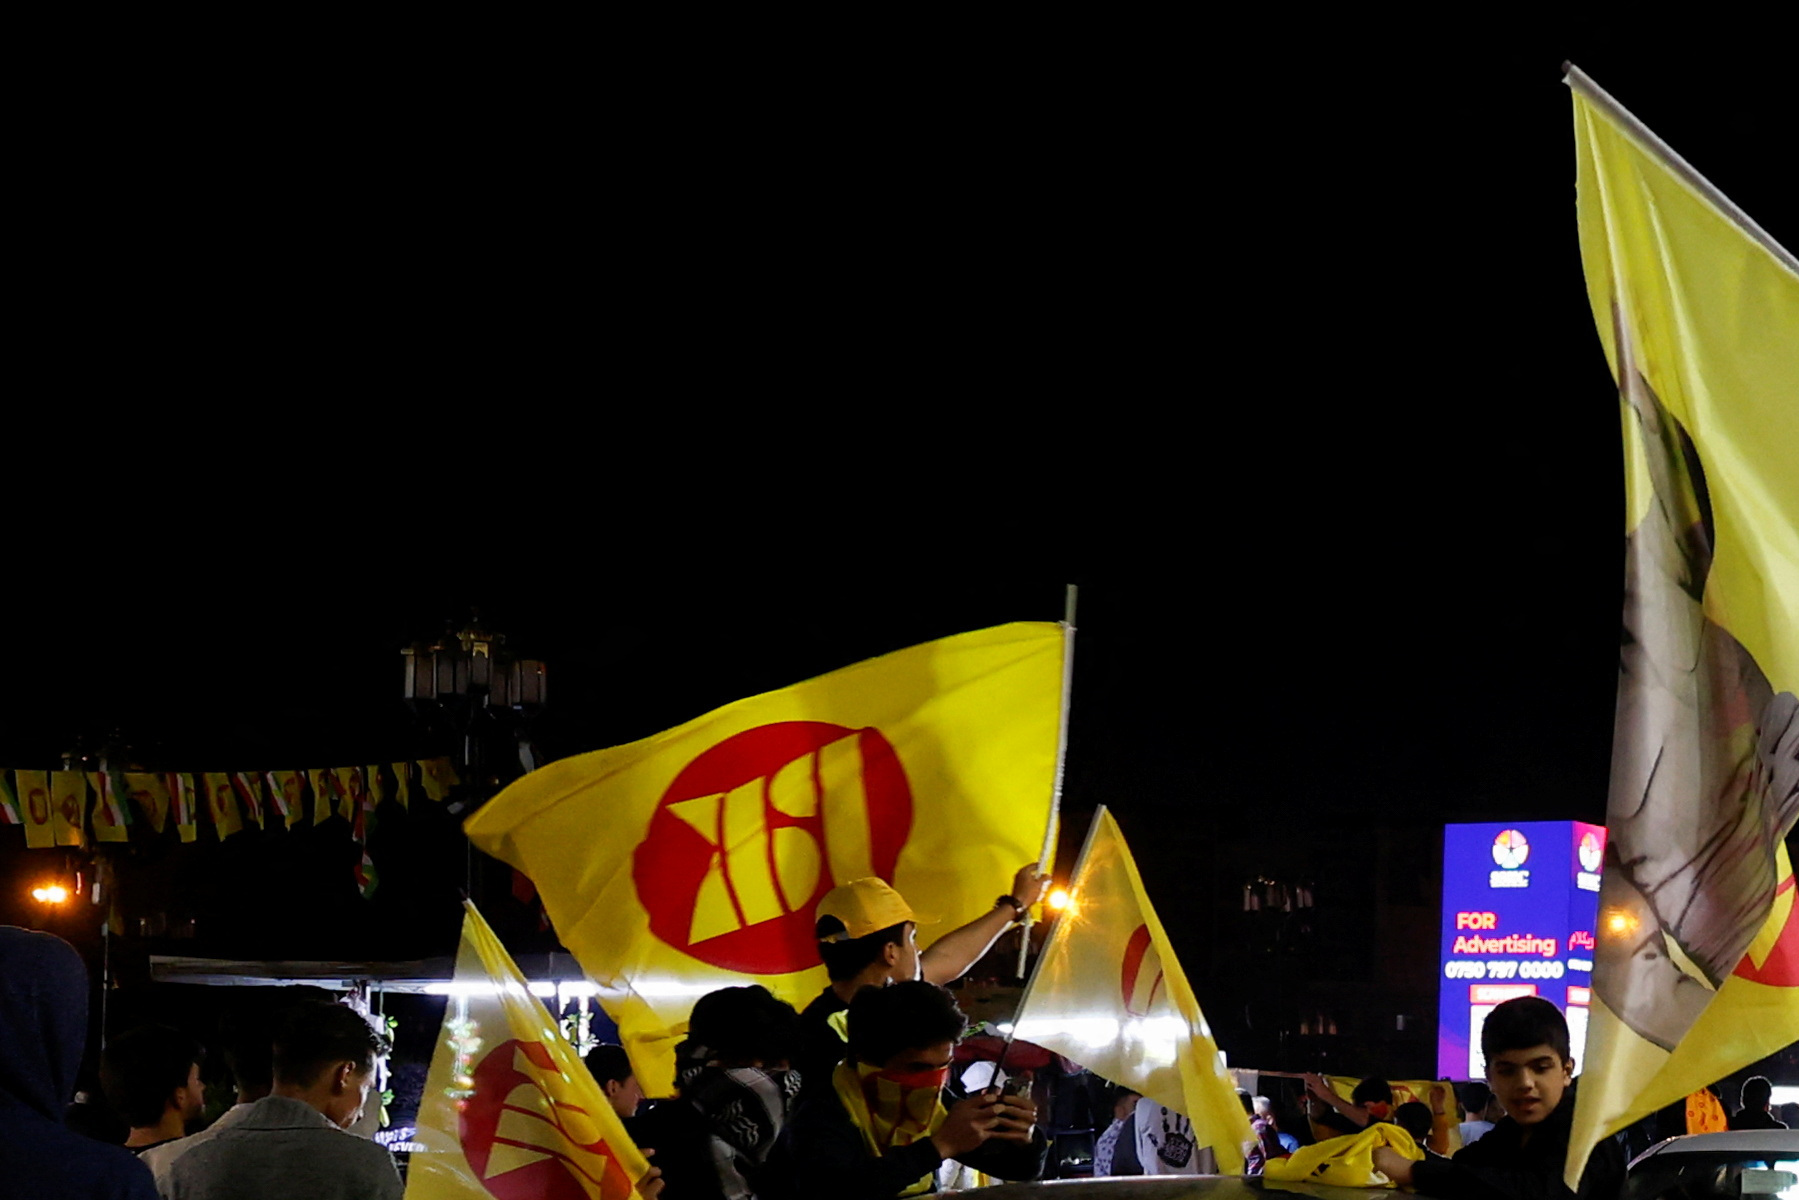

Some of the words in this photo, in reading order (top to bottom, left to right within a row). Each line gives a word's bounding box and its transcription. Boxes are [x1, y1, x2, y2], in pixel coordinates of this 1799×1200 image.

[1457, 911, 1497, 930] FOR
[1454, 934, 1557, 957] Advertising
[1445, 961, 1486, 979] 0750
[1519, 961, 1565, 979] 0000
